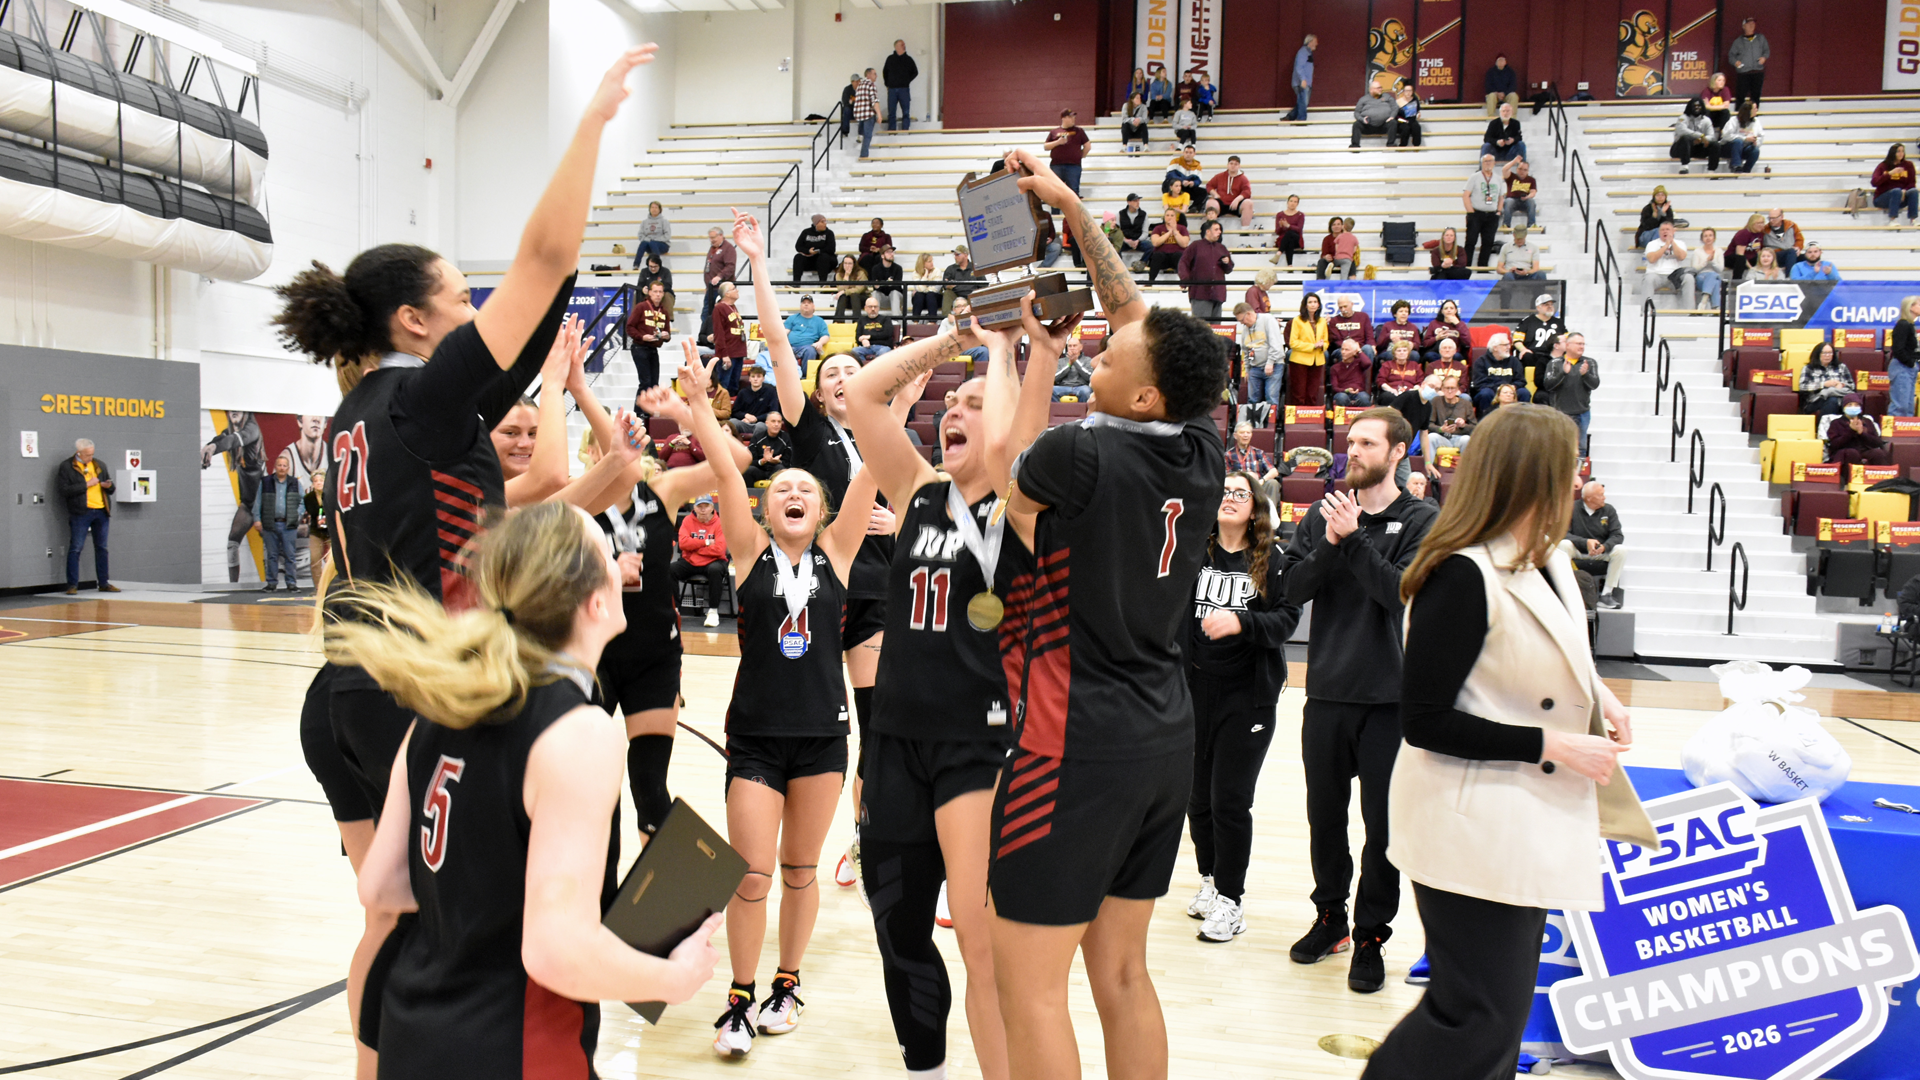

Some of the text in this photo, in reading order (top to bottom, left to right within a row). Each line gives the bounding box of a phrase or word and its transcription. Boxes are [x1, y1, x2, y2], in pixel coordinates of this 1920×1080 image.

[1147, 0, 1167, 84] OLDEN
[1190, 0, 1211, 84] NIGHT
[1672, 52, 1697, 60] THIS
[1897, 0, 1920, 74] GOLD
[1419, 58, 1443, 67] THIS
[1419, 67, 1451, 76] IS OUR
[1671, 61, 1706, 70] IS OUR
[969, 220, 988, 235] PSAC
[575, 297, 596, 305] 2026
[1739, 295, 1799, 310] PSAC
[1831, 306, 1908, 323] CHAMP
[56, 394, 165, 418] RESTROOMS
[333, 420, 372, 513] 21
[910, 524, 966, 562] IUP
[1157, 498, 1184, 578] 1
[773, 573, 820, 598] IP
[910, 566, 950, 632] 11
[1196, 567, 1258, 610] IUP
[1768, 750, 1809, 791] W BASKET
[421, 754, 466, 873] 5
[1606, 805, 1755, 875] PSAC
[1634, 905, 1798, 961] BASKETBALL
[1573, 928, 1895, 1032] CHAMPIONS
[1721, 1023, 1782, 1054] 2026
